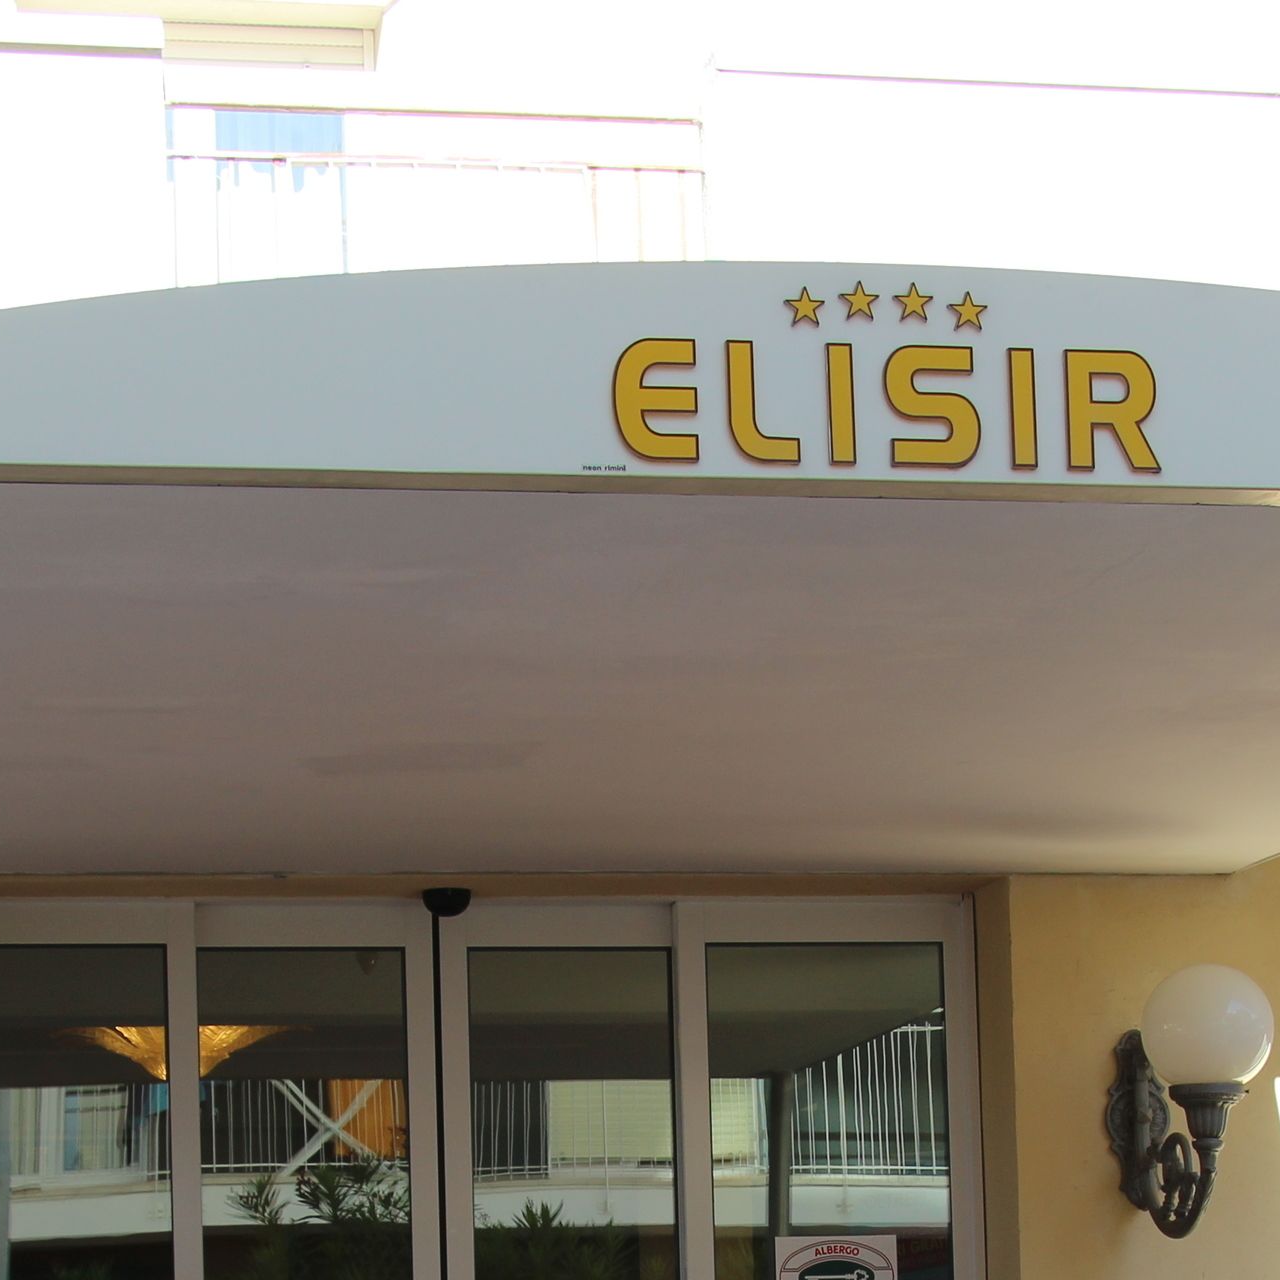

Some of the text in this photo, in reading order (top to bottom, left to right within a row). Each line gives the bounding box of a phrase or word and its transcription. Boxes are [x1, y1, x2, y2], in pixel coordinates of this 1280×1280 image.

[612, 337, 1162, 474] ELISIR
[582, 463, 627, 472] neon rimini
[814, 1245, 860, 1257] ALBERGO
